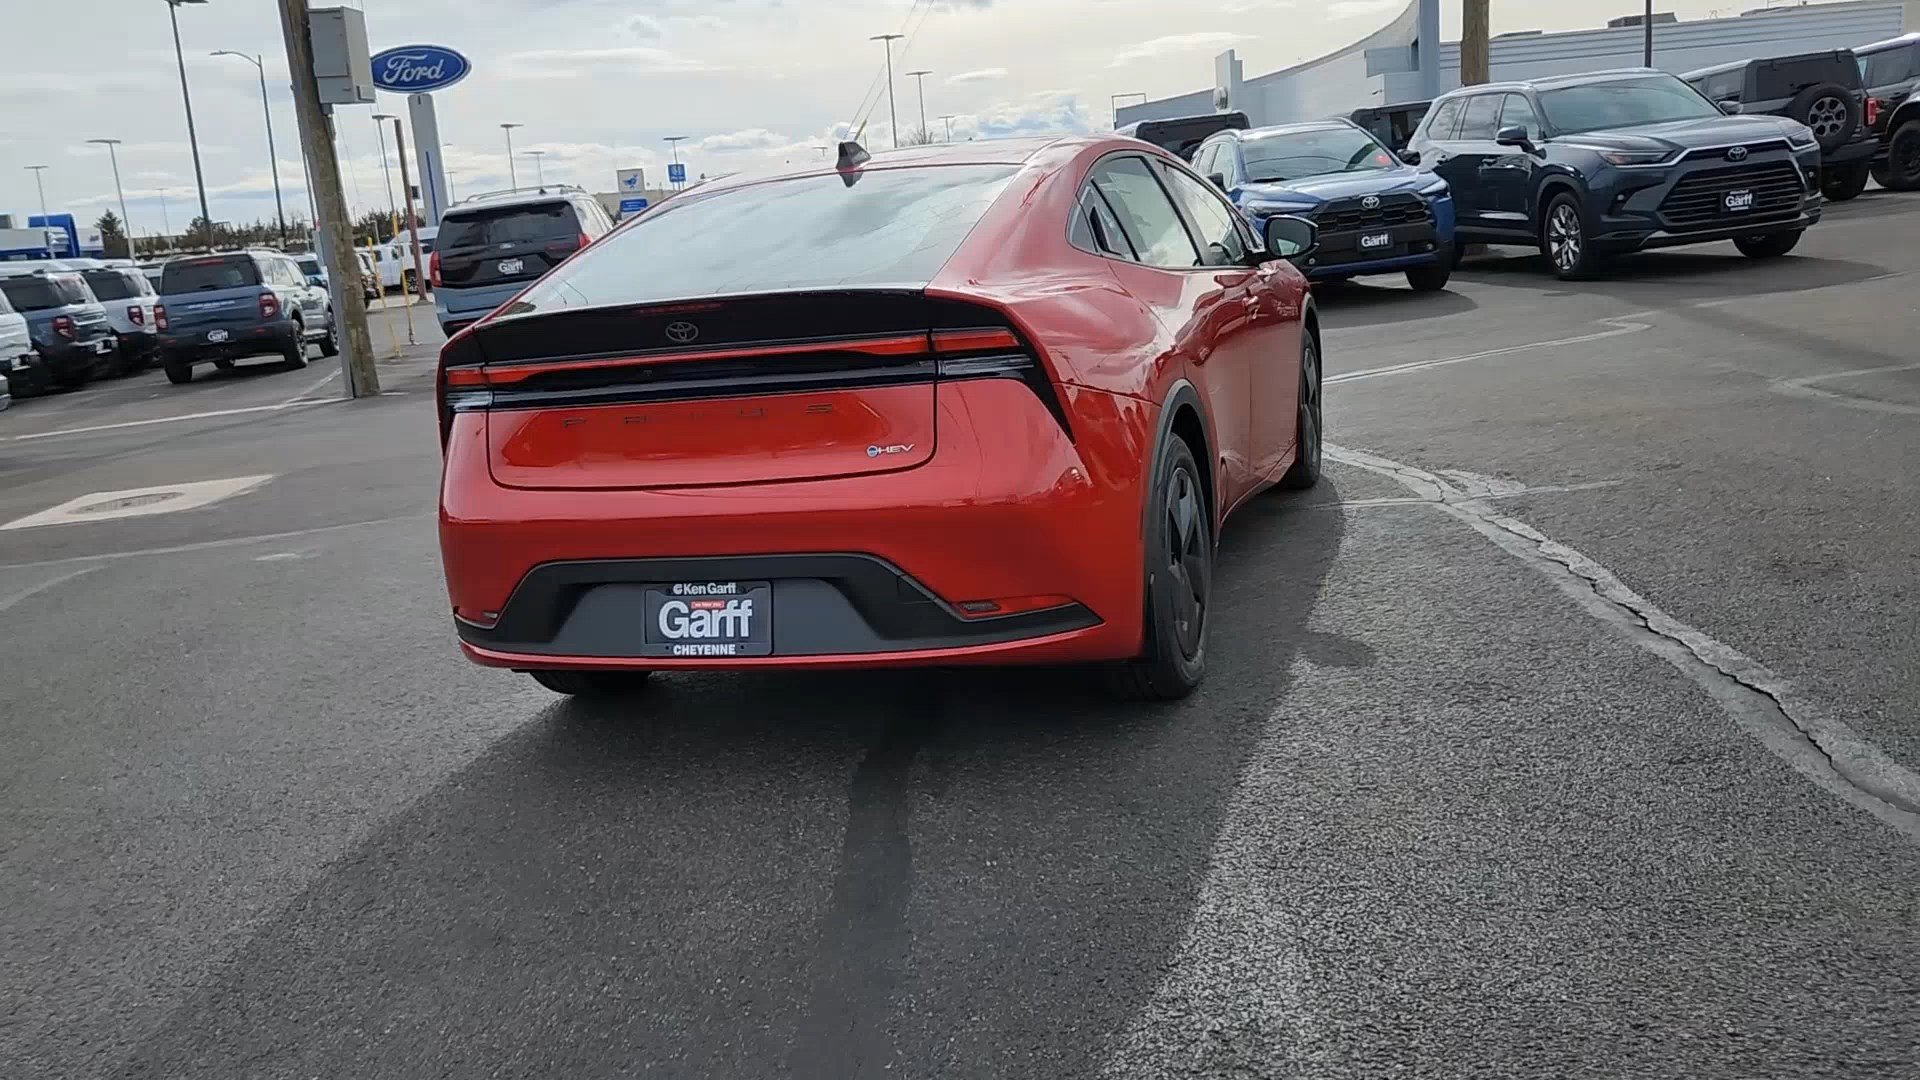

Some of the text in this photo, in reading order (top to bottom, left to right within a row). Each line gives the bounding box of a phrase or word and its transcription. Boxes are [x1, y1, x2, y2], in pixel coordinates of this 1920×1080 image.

[383, 54, 445, 84] Ford
[1725, 193, 1753, 207] Garff
[1361, 234, 1388, 247] Garff
[562, 402, 834, 428] PRUS
[878, 444, 915, 454] HEV
[683, 582, 737, 595] Ken Garff
[658, 600, 753, 639] Garff
[673, 644, 736, 656] CHEYENNE
